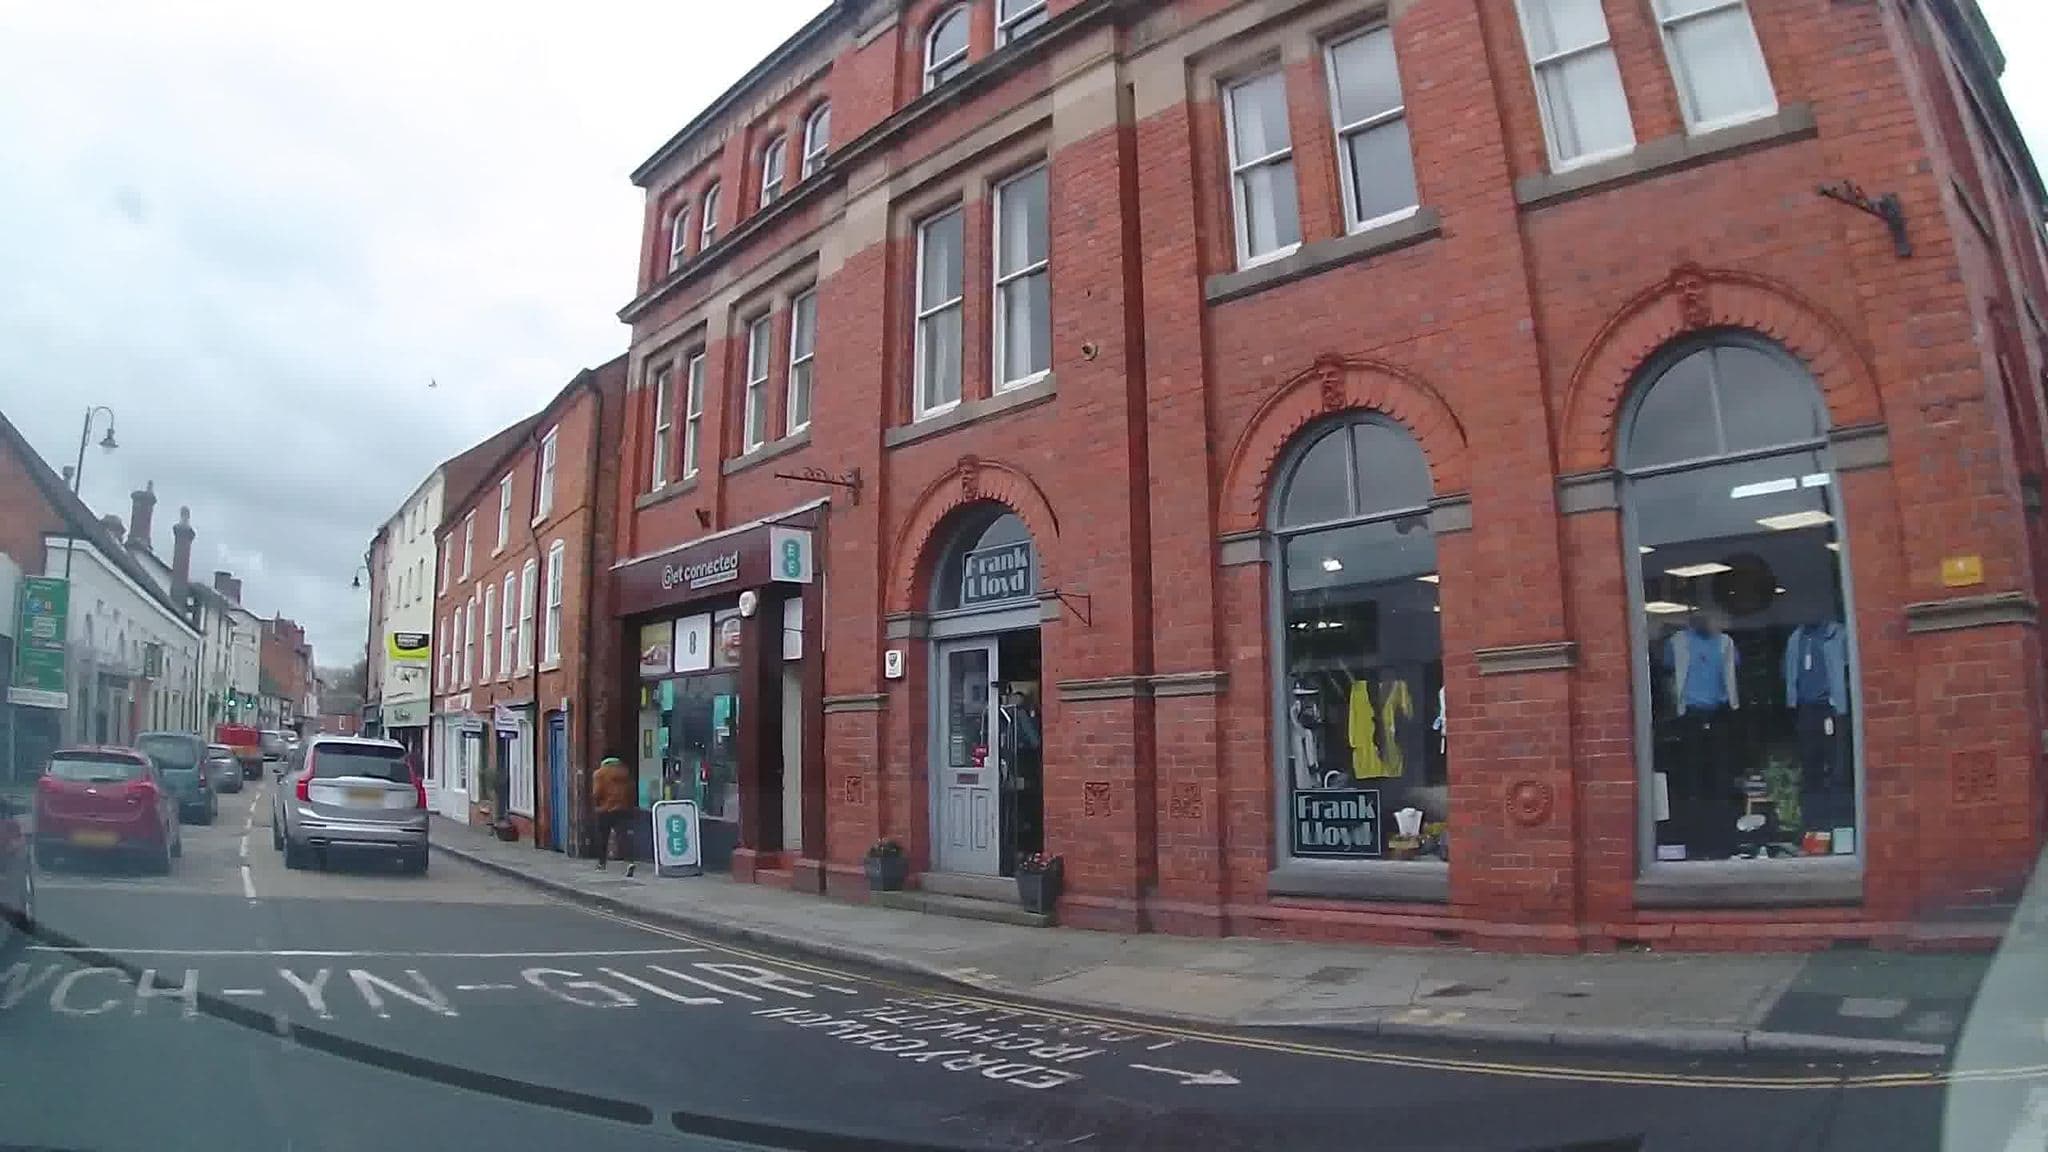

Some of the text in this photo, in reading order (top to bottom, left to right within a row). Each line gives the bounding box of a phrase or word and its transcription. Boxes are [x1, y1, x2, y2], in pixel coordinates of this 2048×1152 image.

[684, 550, 740, 580] connected
[965, 547, 1028, 578] Frank
[966, 569, 1026, 599] Lloyd
[1297, 795, 1376, 820] Frank
[1300, 821, 1373, 851] Lloyd
